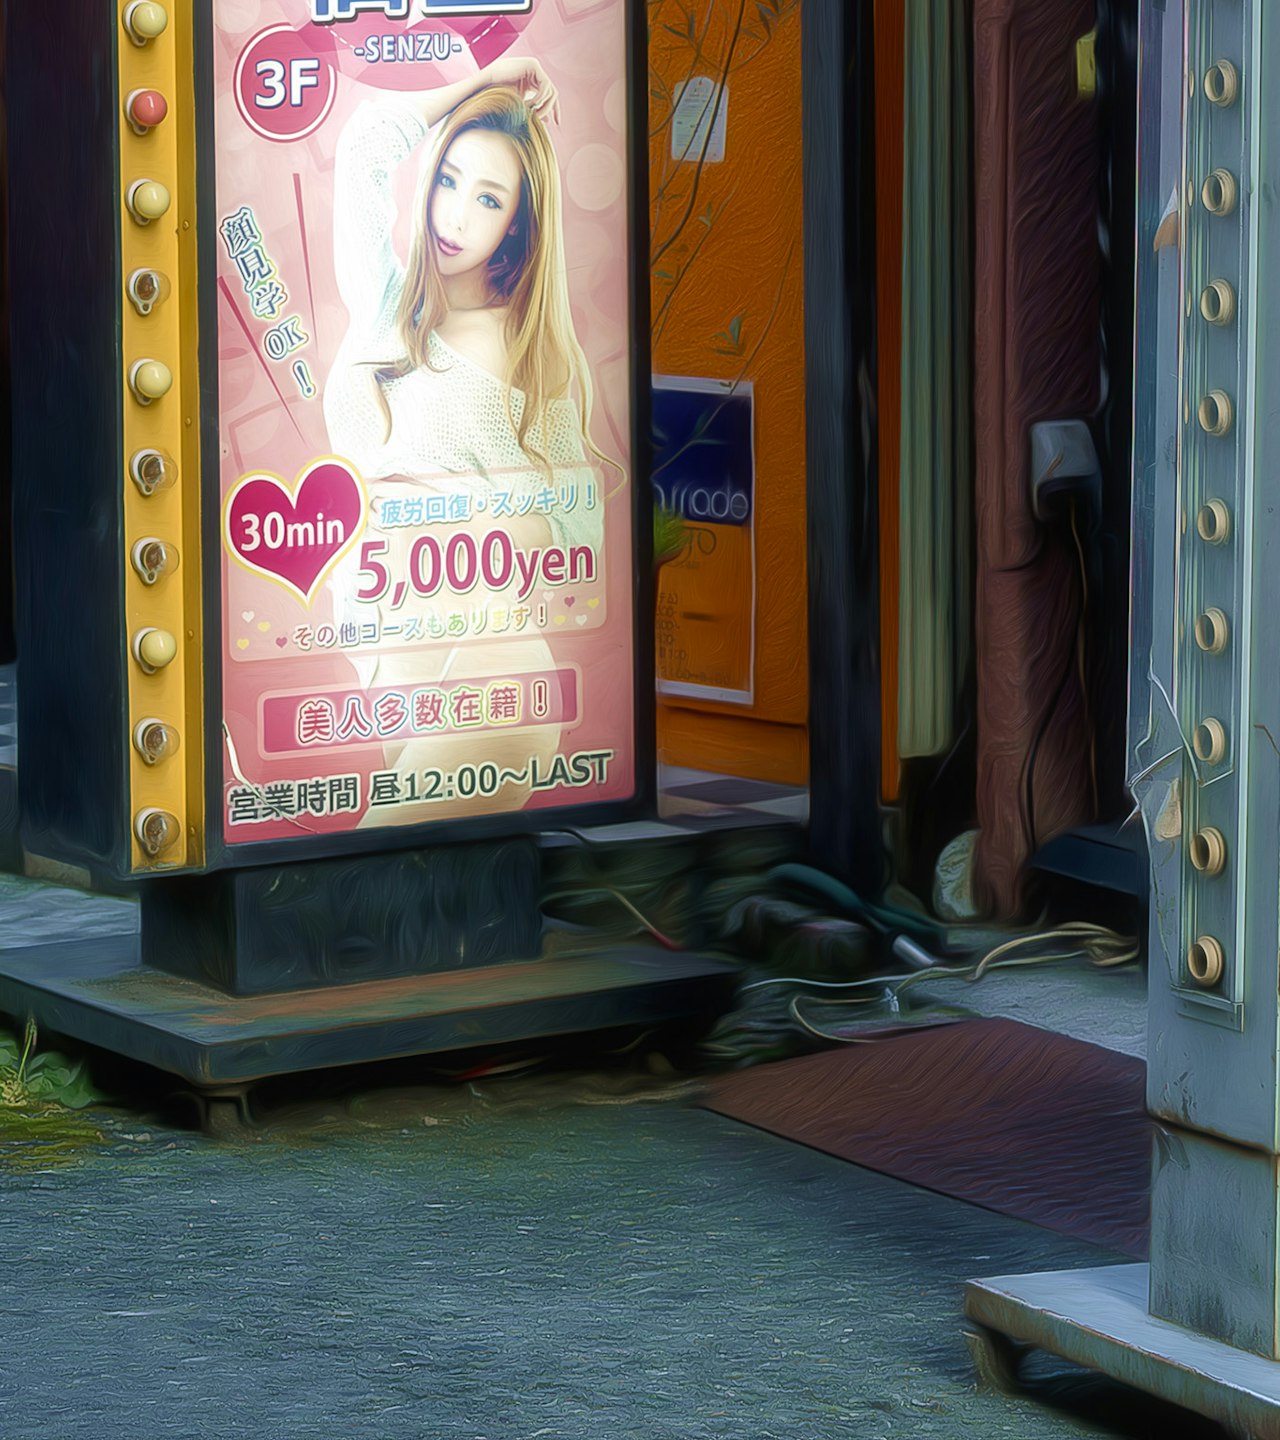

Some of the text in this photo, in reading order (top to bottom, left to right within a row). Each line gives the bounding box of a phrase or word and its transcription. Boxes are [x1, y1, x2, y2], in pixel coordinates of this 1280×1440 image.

[353, 32, 463, 63] -SENZU-
[254, 58, 320, 108] 3F
[240, 511, 345, 552] 30min
[356, 529, 596, 607] 5,000yen
[293, 605, 547, 650] その他コースもあります！
[299, 681, 549, 743] 美人多数在籍！
[229, 776, 359, 823] 営業時間
